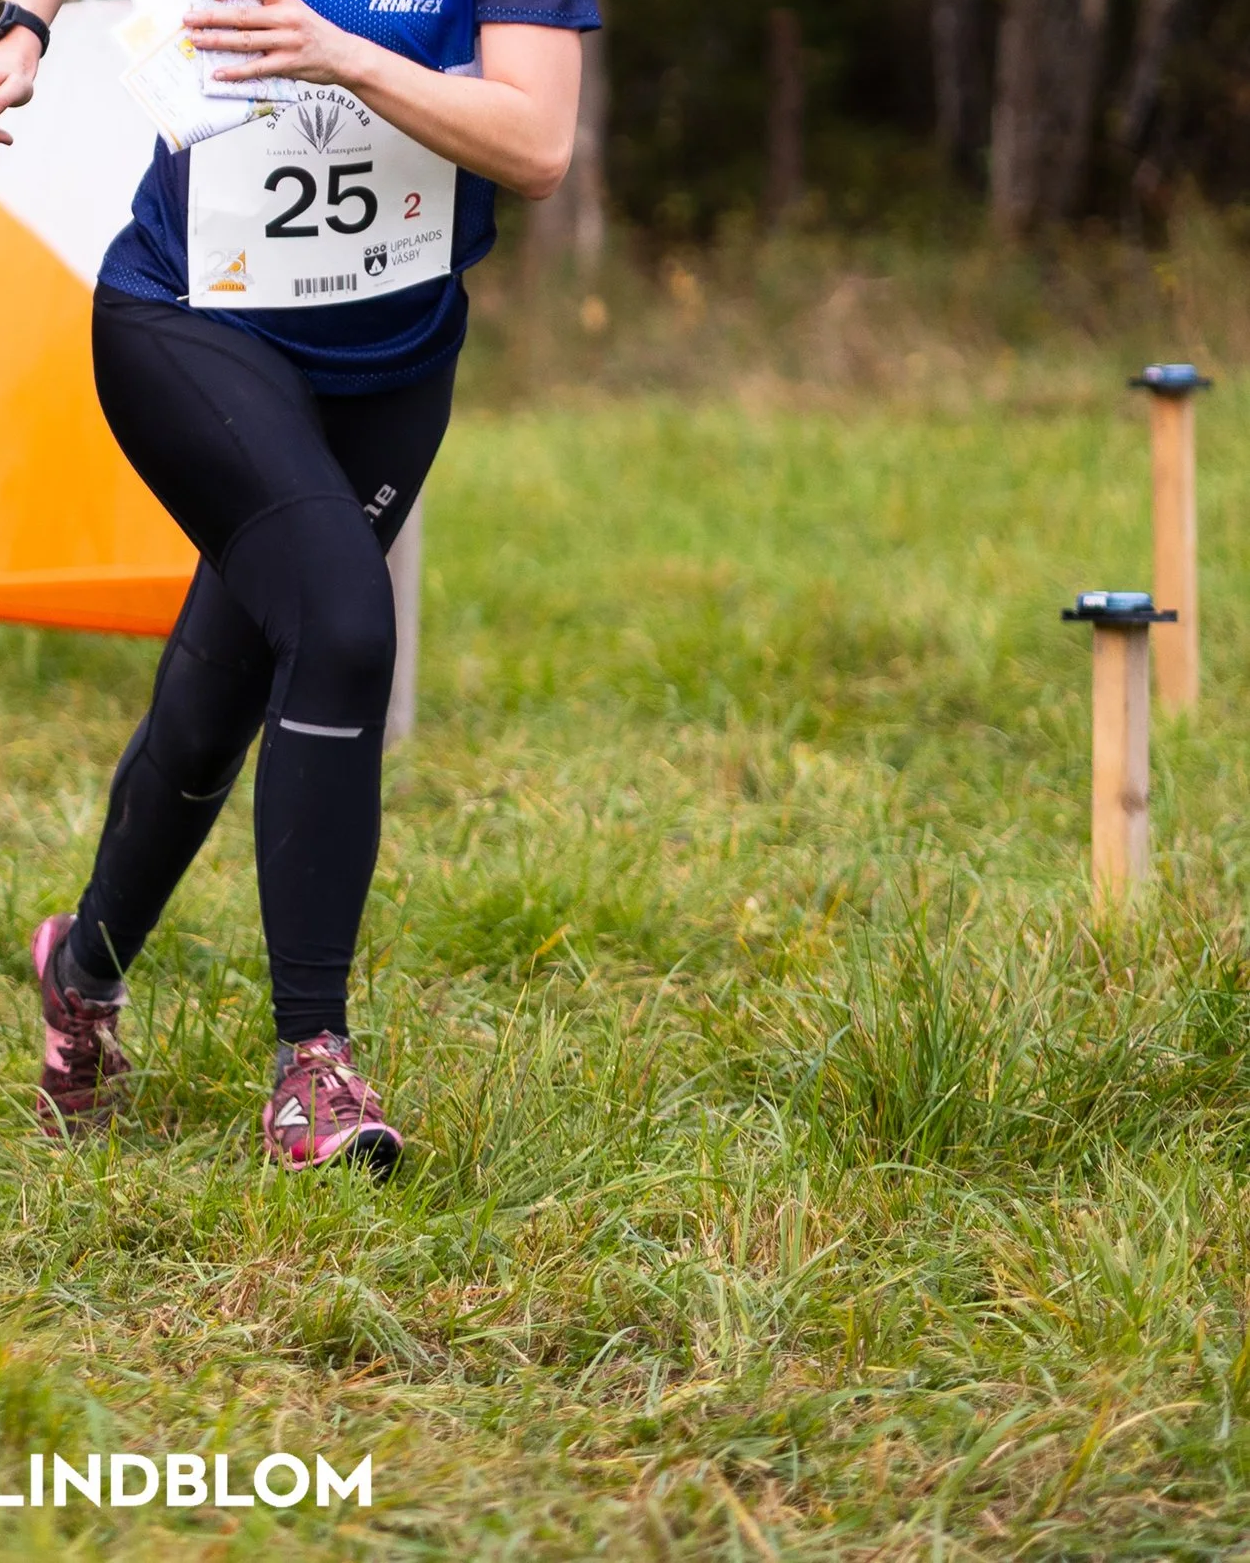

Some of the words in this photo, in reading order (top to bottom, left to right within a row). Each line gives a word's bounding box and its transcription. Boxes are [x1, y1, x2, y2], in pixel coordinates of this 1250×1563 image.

[316, 89, 356, 111] GÅRD
[354, 108, 371, 127] AB
[263, 160, 378, 238] 25
[403, 192, 421, 219] 2
[390, 229, 443, 253] UPPLANDS
[391, 248, 421, 266] VÄSBY
